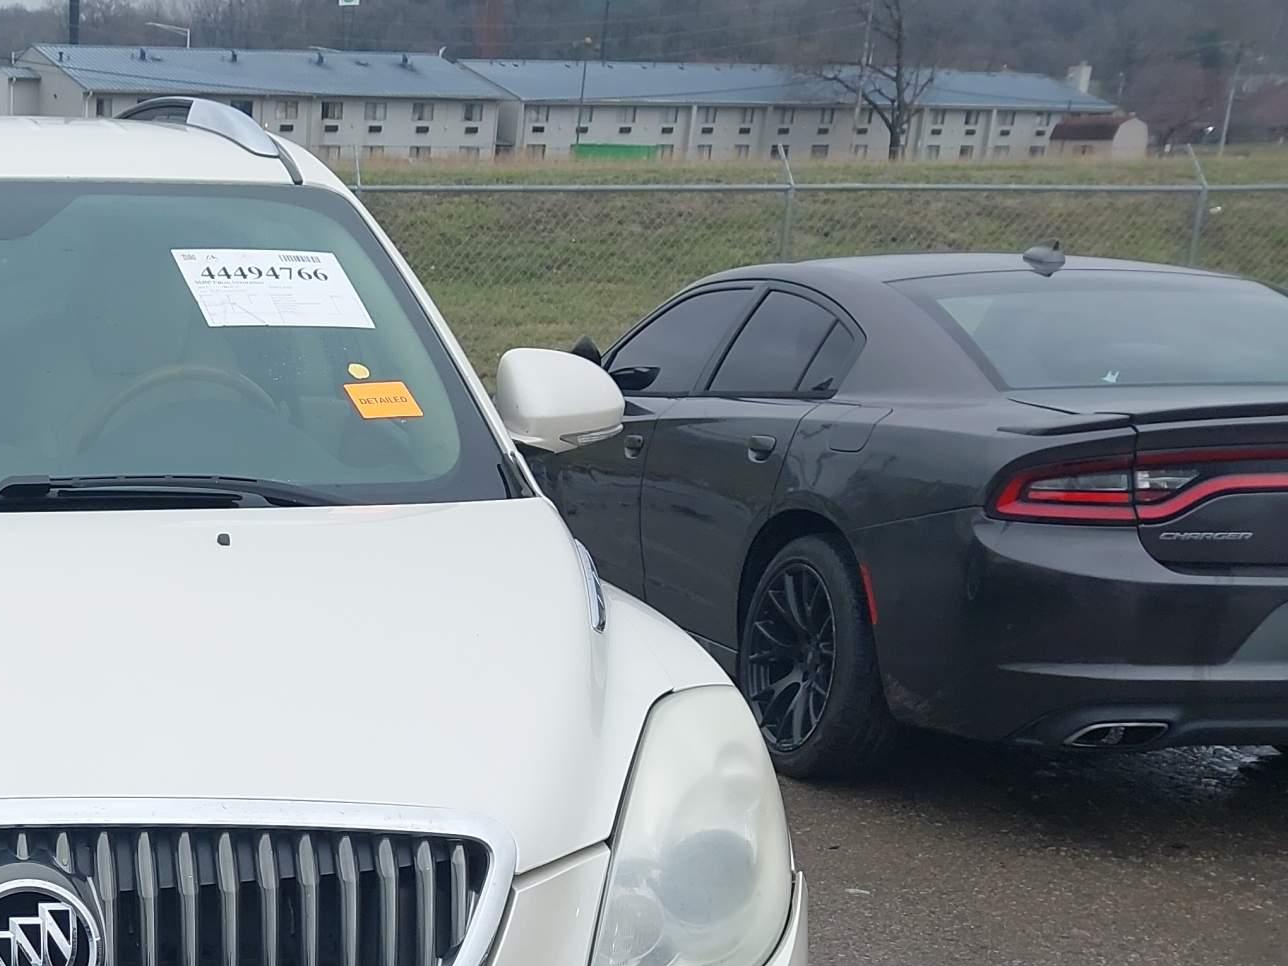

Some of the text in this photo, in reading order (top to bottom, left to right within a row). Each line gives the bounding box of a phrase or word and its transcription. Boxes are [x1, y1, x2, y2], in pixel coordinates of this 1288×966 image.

[200, 266, 329, 282] 44494766
[358, 395, 409, 406] DETAILED
[1159, 531, 1254, 541] CHARGER
